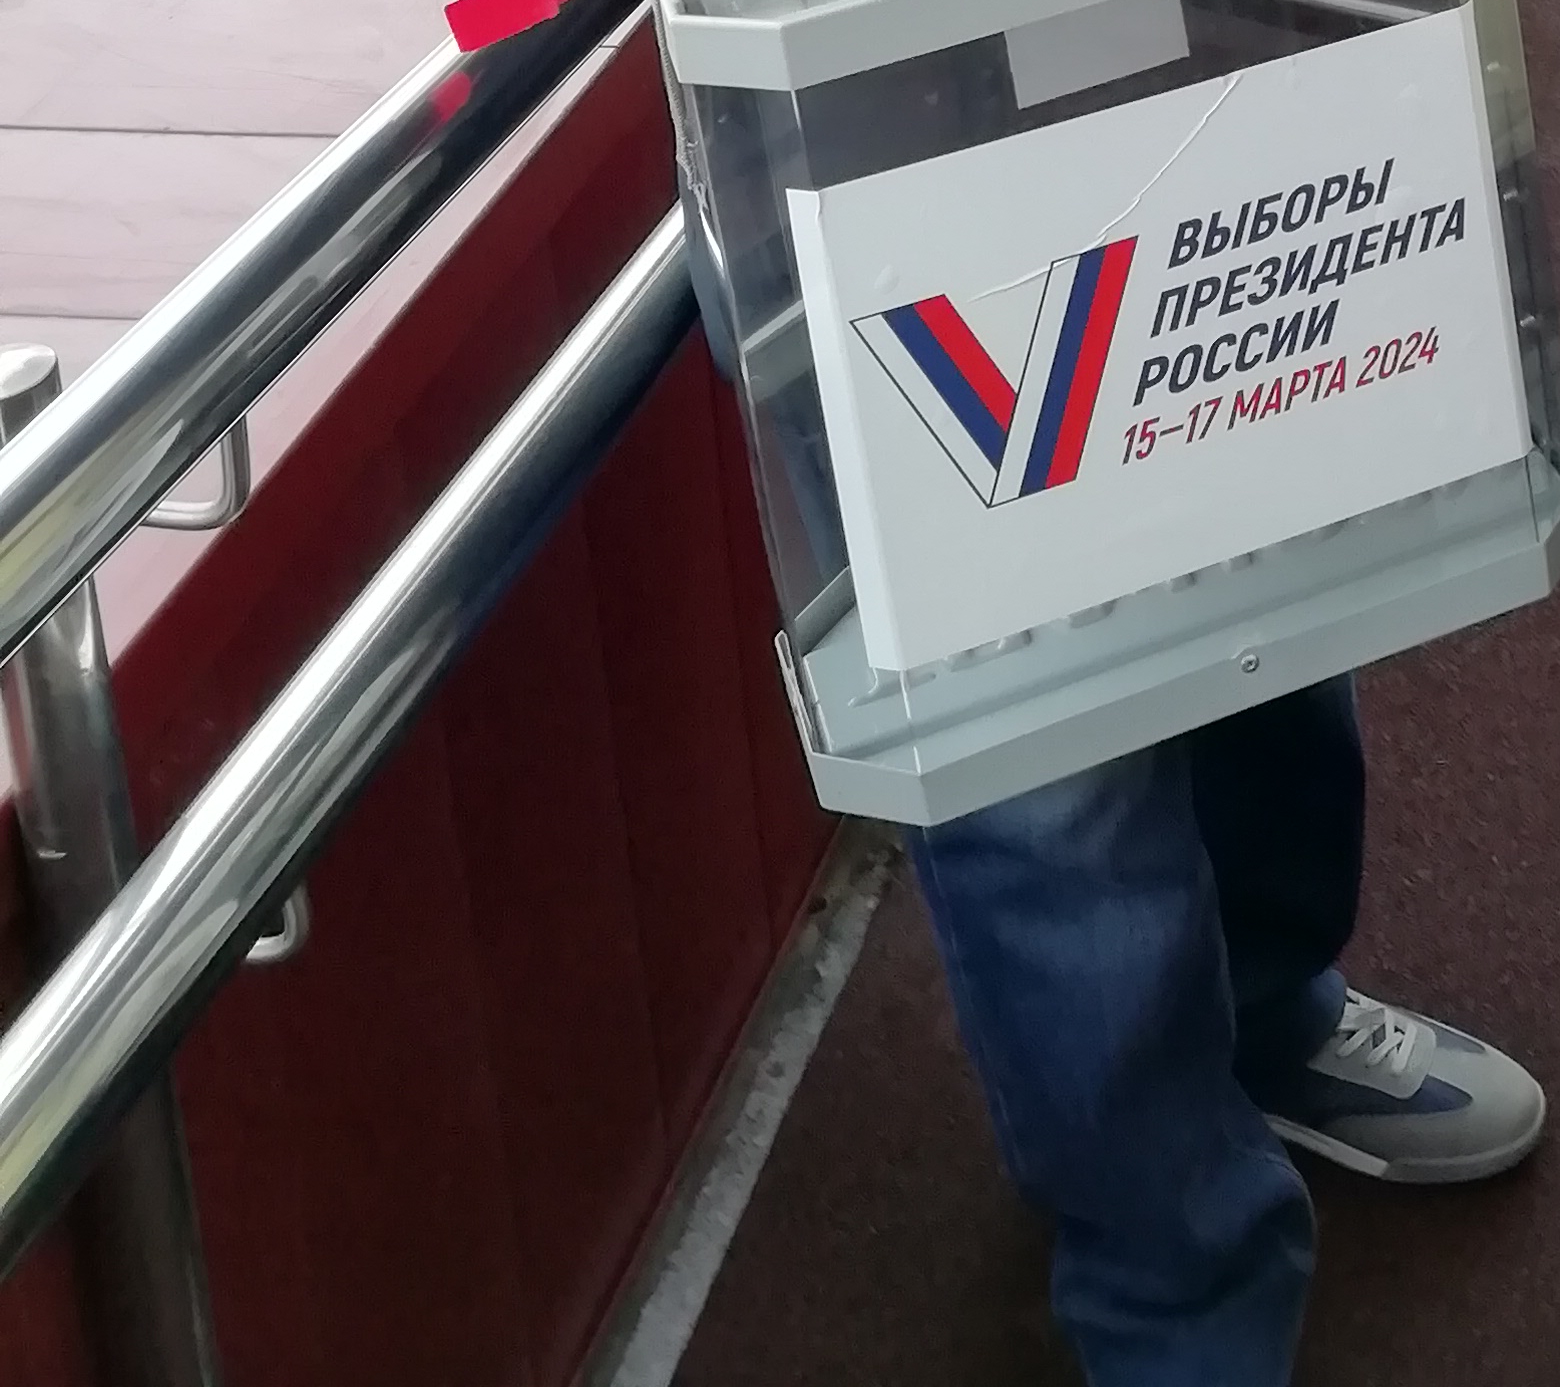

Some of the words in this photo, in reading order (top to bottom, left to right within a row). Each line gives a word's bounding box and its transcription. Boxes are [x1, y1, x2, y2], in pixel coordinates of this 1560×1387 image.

[1150, 197, 1465, 339] ПРЕЗИДЕНТА
[1167, 158, 1394, 270] ВЫБОРЫ
[1133, 298, 1340, 407] РОССИИ
[1227, 356, 1347, 431] МАРТА
[1355, 325, 1440, 388] 2024
